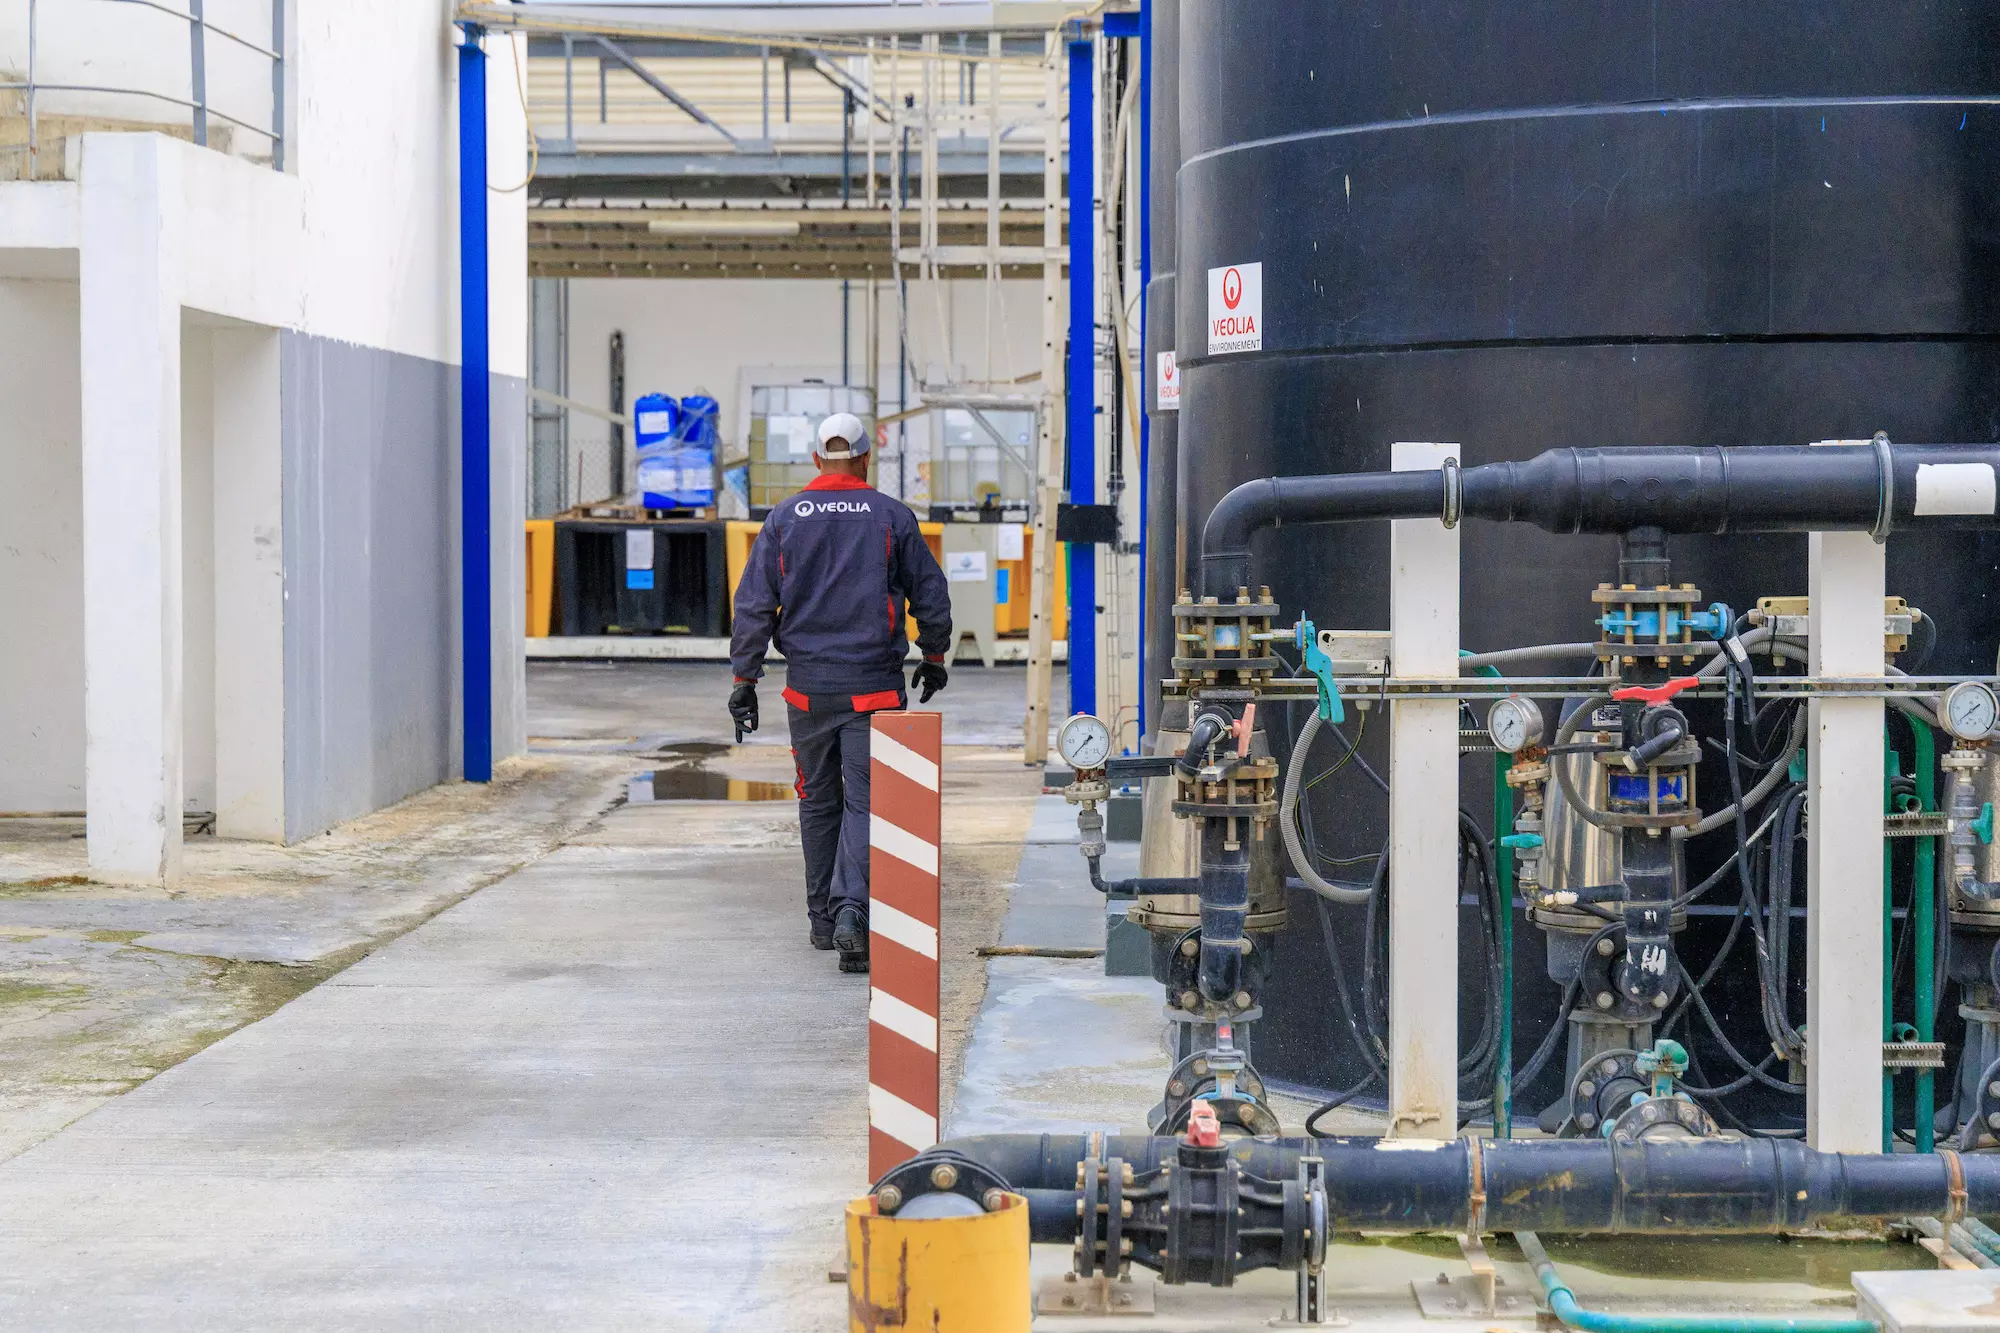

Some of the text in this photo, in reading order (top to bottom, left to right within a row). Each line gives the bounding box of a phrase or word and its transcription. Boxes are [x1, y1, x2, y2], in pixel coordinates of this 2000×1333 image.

[1212, 315, 1255, 337] VEOLIA
[1209, 339, 1261, 353] ENVIRONNEMENT
[1160, 386, 1181, 398] VEOLIA
[816, 501, 871, 513] VEOLIA
